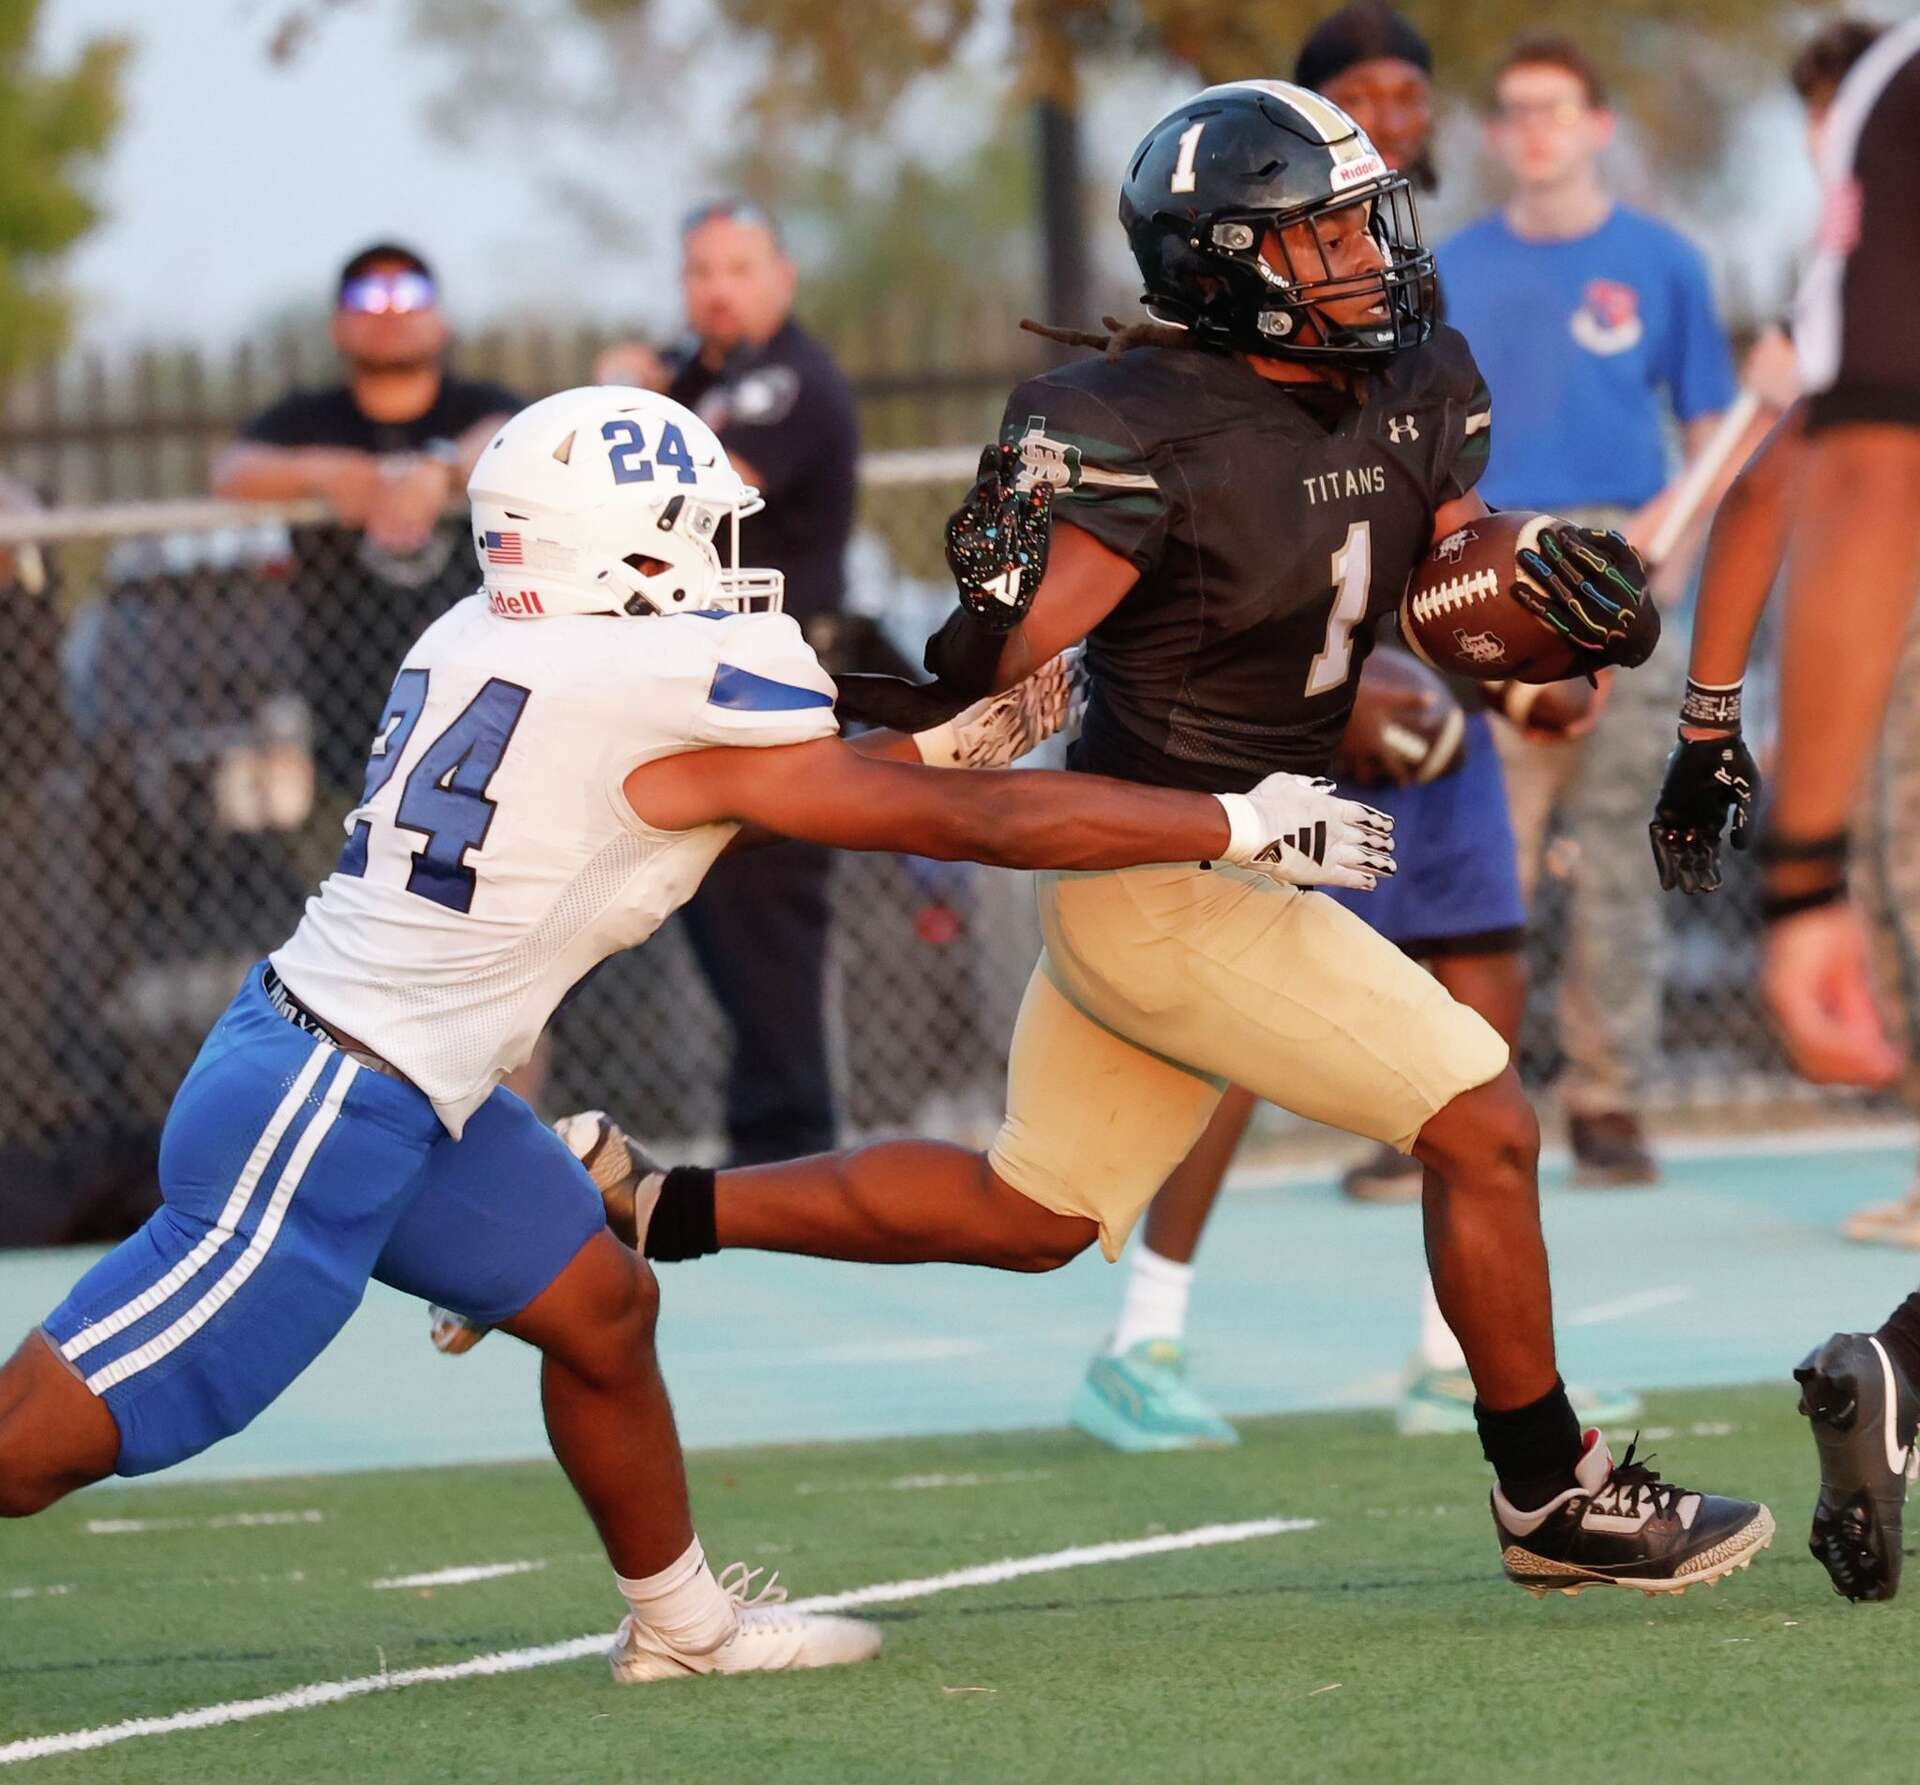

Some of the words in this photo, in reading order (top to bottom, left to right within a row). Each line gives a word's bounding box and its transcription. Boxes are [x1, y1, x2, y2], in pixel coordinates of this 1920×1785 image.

[1171, 122, 1205, 193] 1
[601, 420, 697, 485] 24
[1303, 466, 1385, 504] TITANS
[1304, 520, 1371, 698] 1
